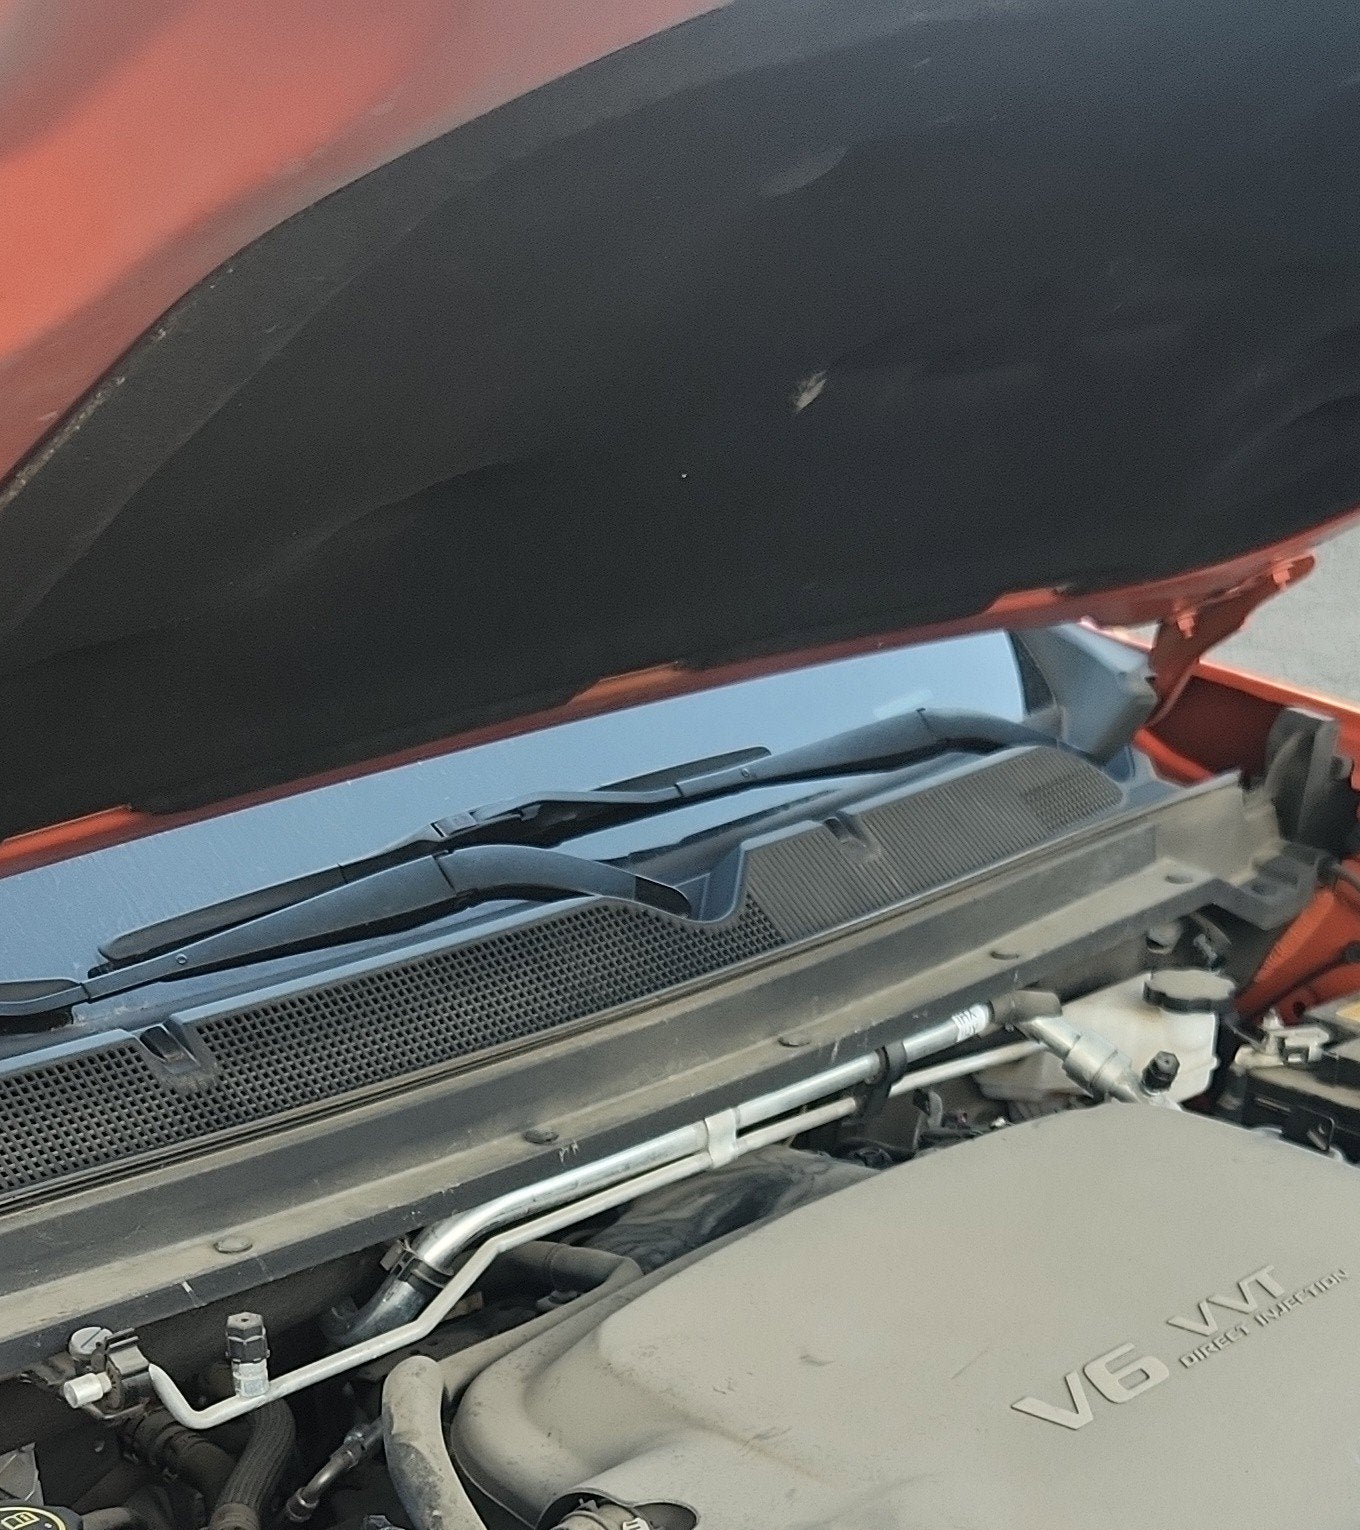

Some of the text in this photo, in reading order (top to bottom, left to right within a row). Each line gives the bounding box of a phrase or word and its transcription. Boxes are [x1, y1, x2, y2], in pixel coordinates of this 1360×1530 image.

[1011, 1265, 1285, 1430] V6 VVT
[1179, 1268, 1349, 1368] DIRECT INJECTION
